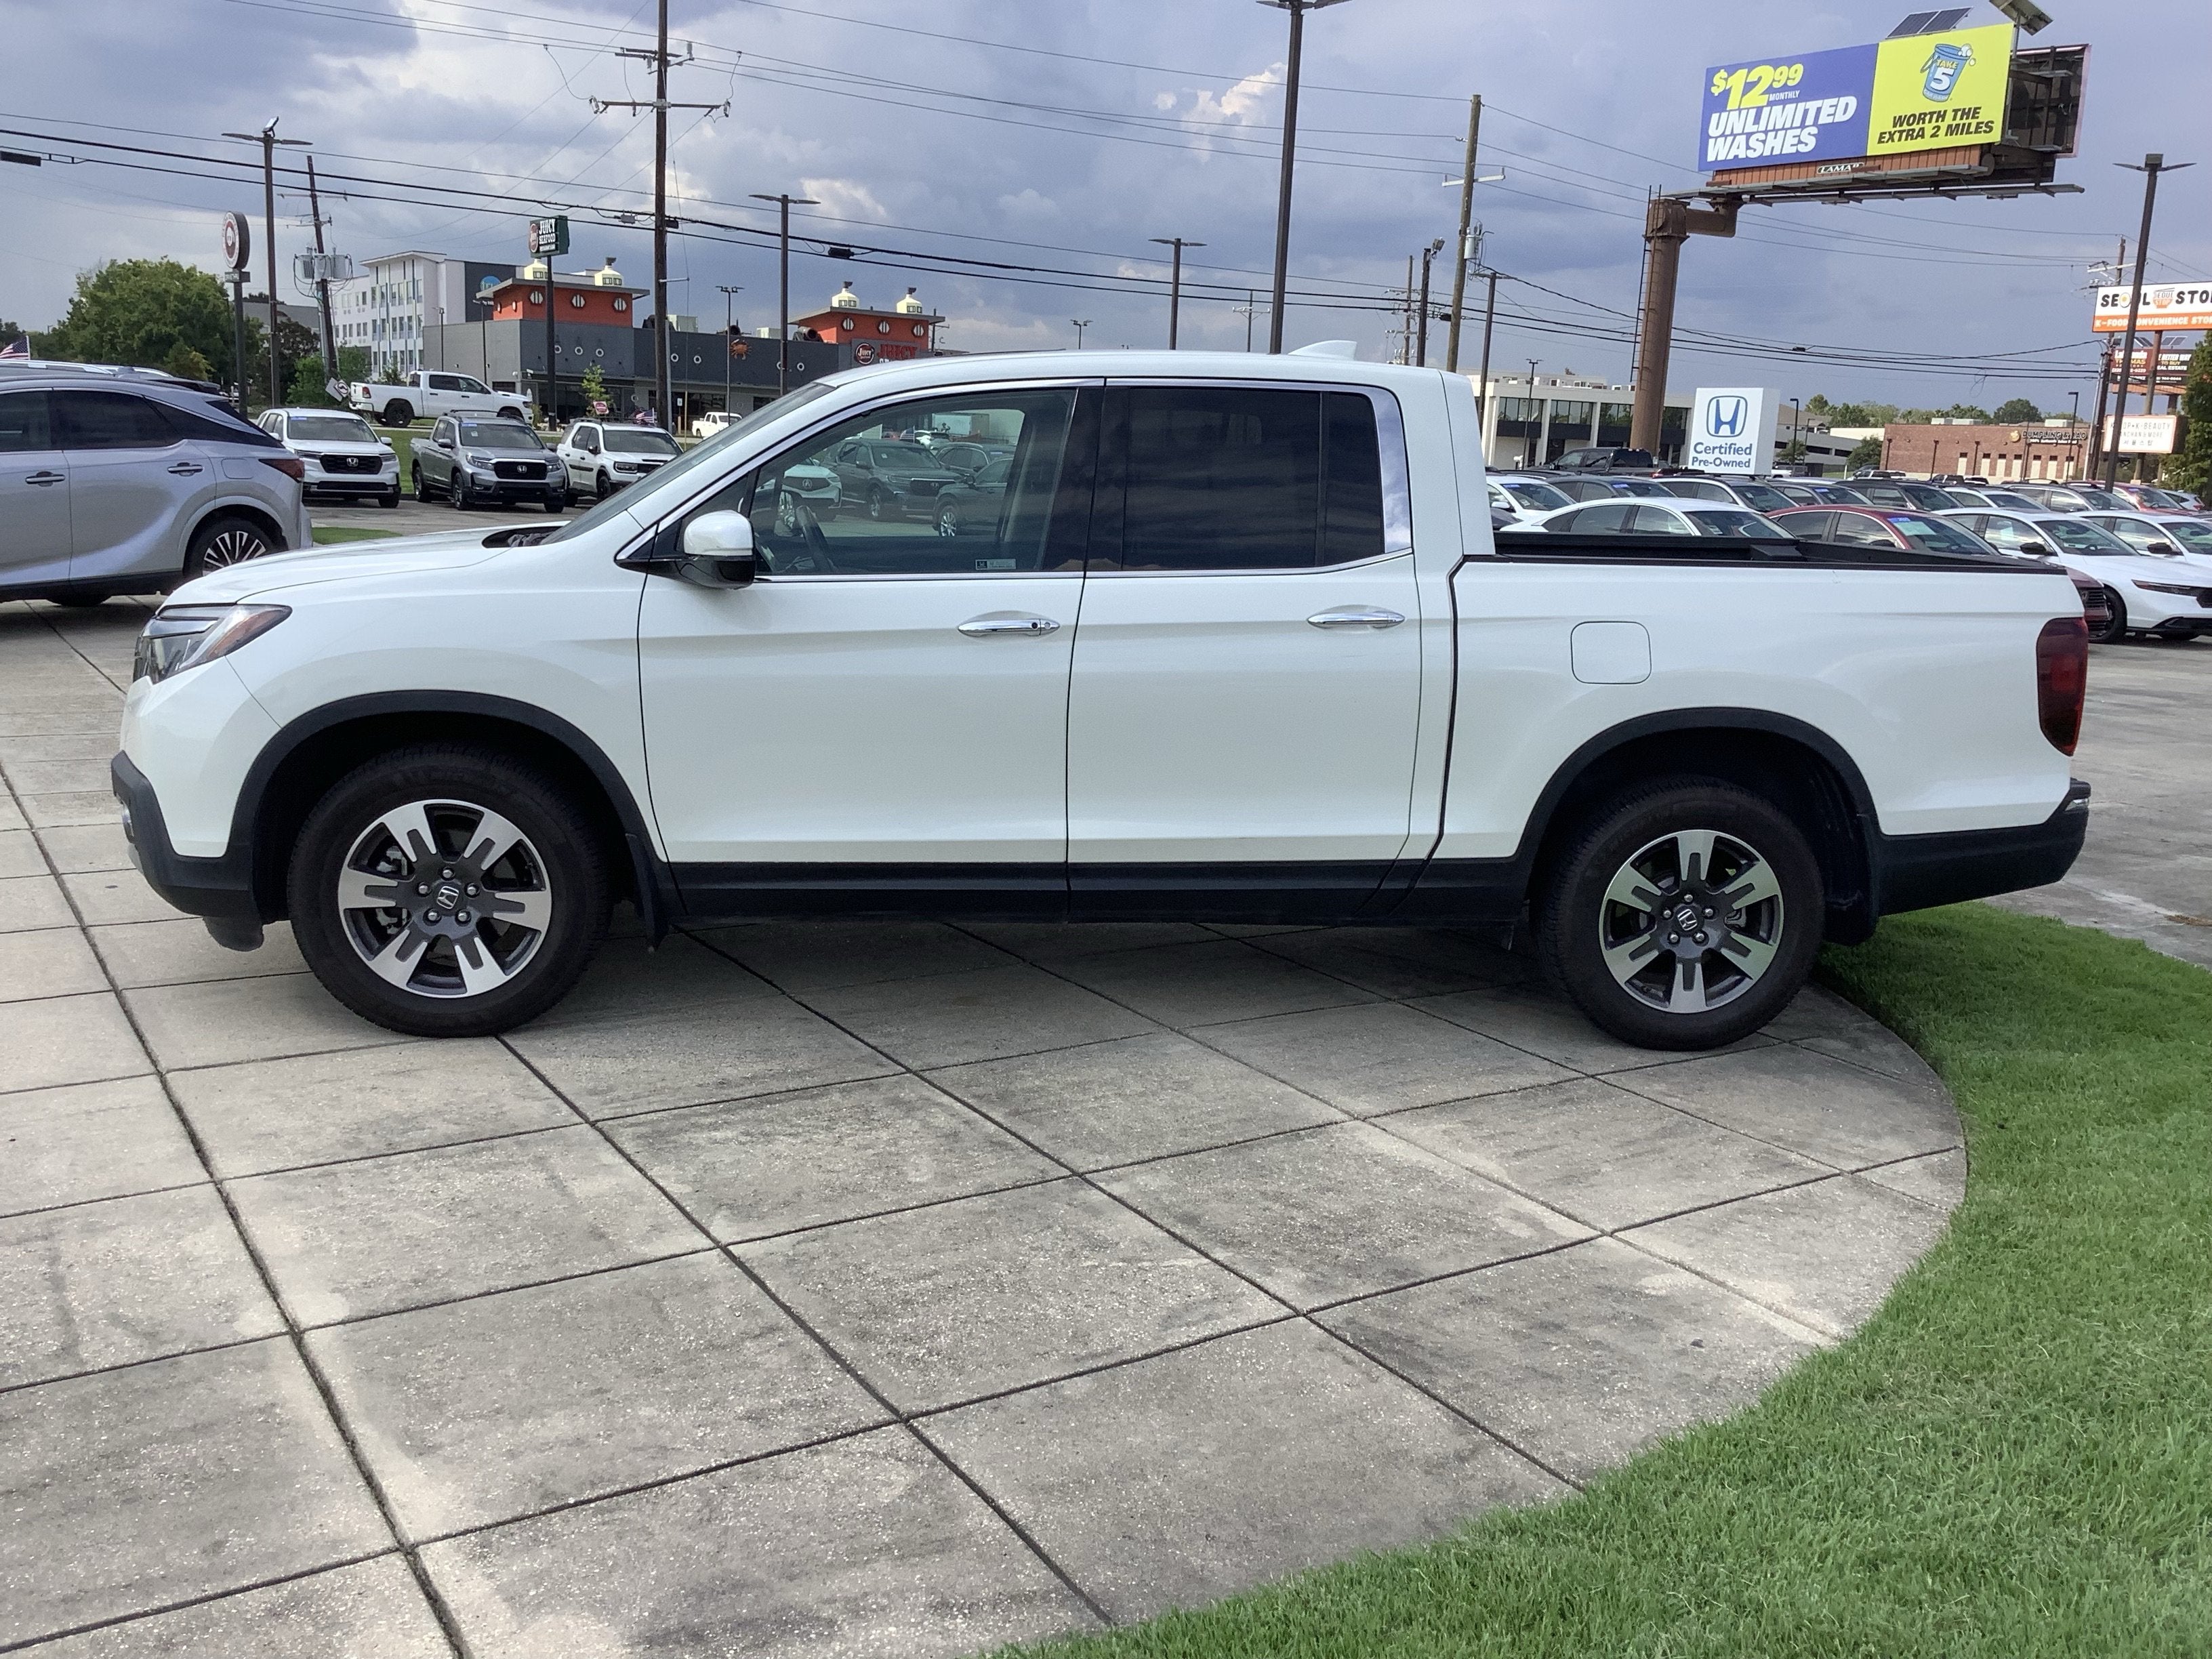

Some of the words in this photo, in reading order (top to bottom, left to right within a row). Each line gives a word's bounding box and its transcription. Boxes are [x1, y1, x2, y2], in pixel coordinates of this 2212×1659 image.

[1936, 58, 1959, 69] TAKE
[1930, 68, 1955, 91] 5
[1769, 90, 1800, 102] MONTHLY
[1708, 96, 1858, 137] UNLIMITED
[1892, 109, 1948, 128] WORTH
[1952, 106, 1982, 122] THE
[1877, 127, 1925, 144] EXTRA
[1930, 125, 1942, 138] 2
[1944, 120, 1994, 136] MILES
[1706, 127, 1819, 162] WASHES
[539, 218, 556, 234] JUICY
[2175, 290, 2212, 304] STO
[877, 344, 918, 359] JUICY
[2023, 430, 2062, 440] DUMPLING
[1694, 442, 1753, 455] Certified
[1692, 456, 1750, 468] Pre-Owned
